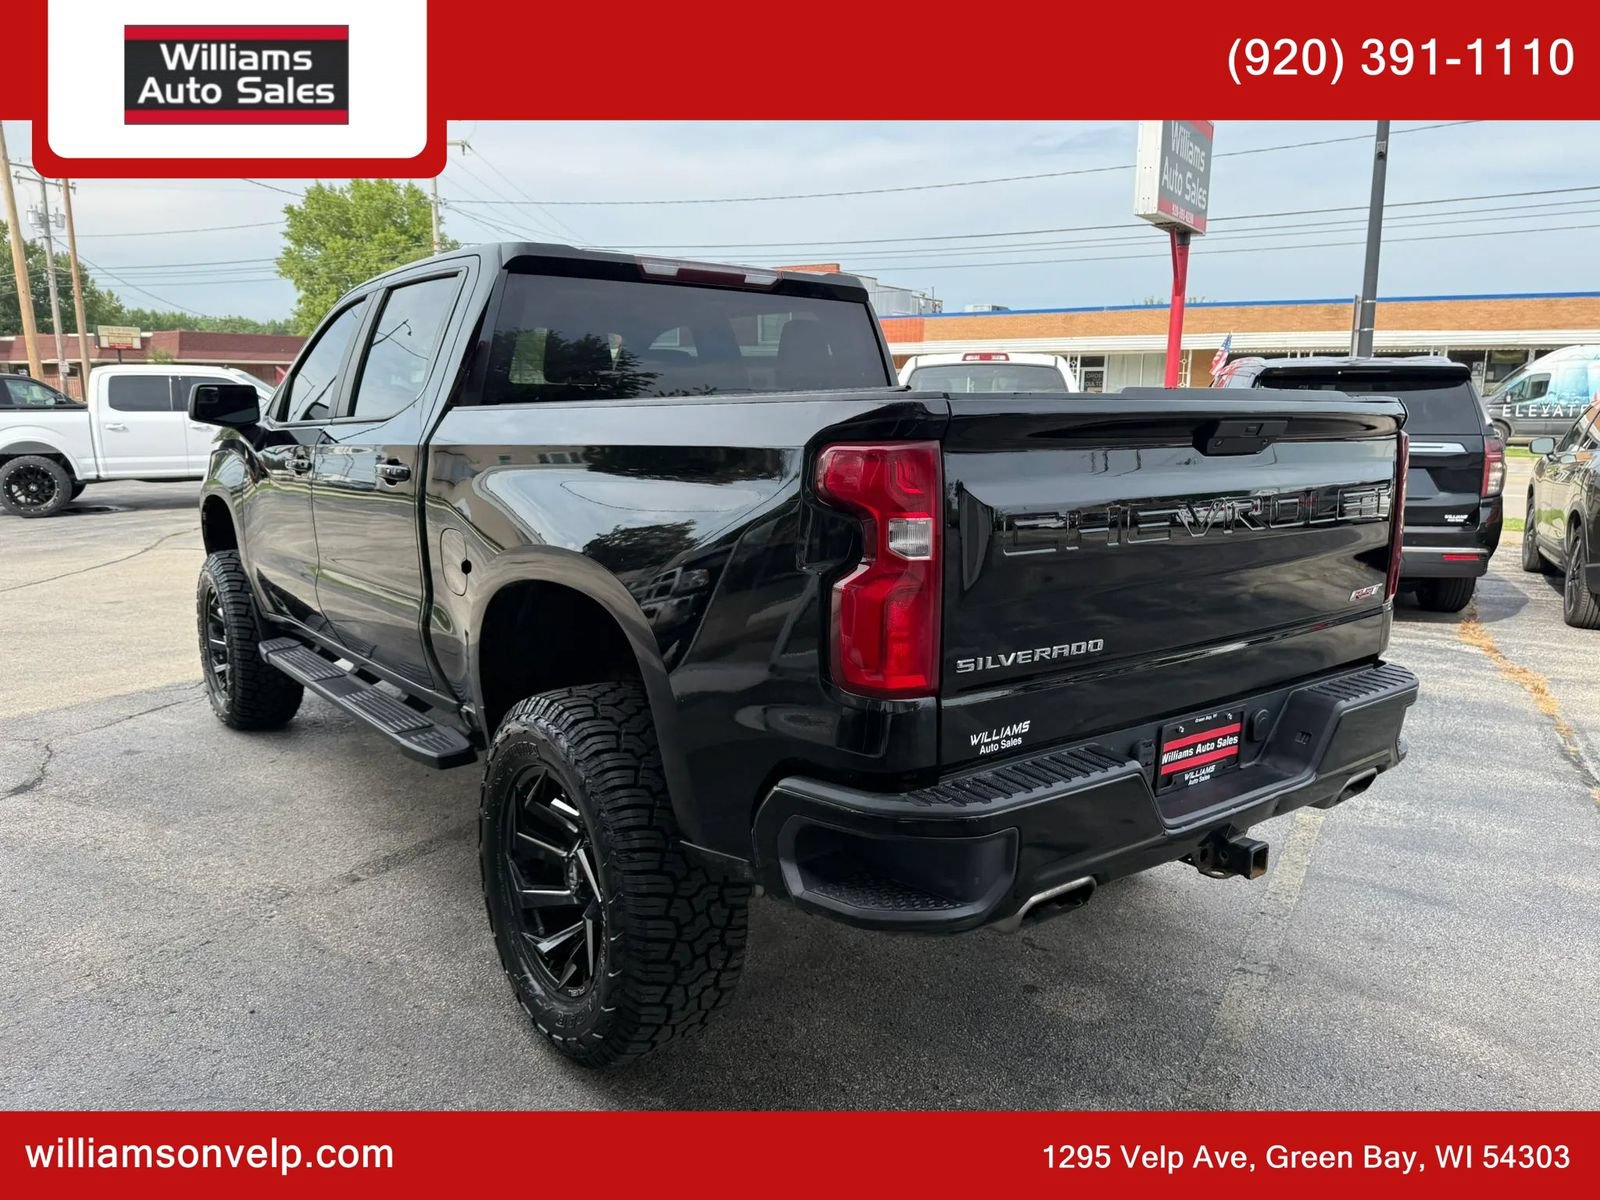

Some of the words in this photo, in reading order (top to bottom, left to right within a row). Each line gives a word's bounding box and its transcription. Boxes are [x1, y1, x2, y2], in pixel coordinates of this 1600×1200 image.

[1171, 120, 1205, 172] Williams
[1162, 156, 1183, 196] Auto
[1185, 171, 1207, 210] Sales
[1002, 482, 1392, 556] CHEVROLET
[956, 638, 1104, 673] SILVERADO
[970, 720, 1031, 746] WILLIAMS
[979, 743, 999, 755] Auto
[1000, 736, 1022, 750] Sales
[1162, 747, 1194, 765] Williams
[1196, 743, 1215, 754] Auto
[1217, 736, 1239, 748] Sales
[1184, 765, 1216, 780] WILLIAMS
